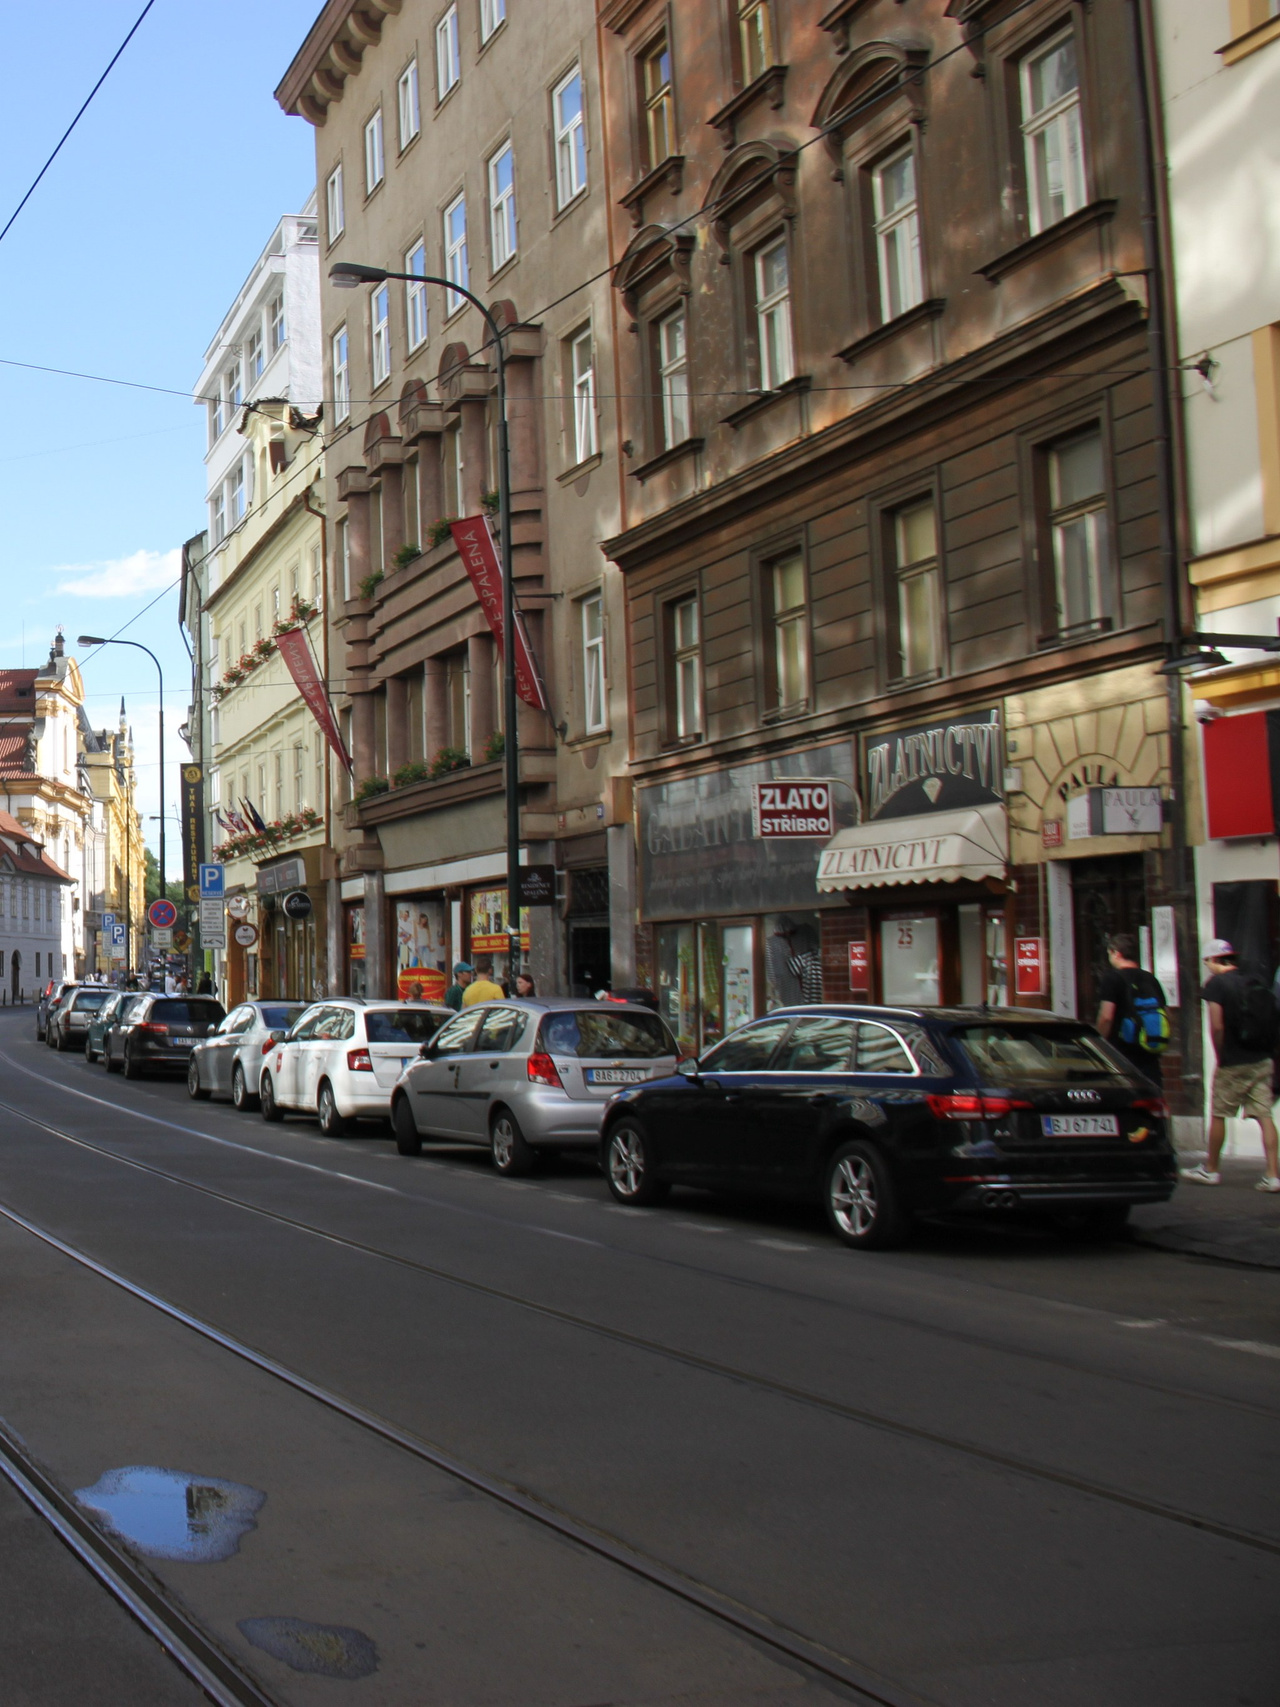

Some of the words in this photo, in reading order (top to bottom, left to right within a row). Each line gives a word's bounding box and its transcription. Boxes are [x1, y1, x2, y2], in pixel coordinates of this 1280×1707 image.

[867, 708, 1004, 819] ZLATNICTVÍ
[1057, 764, 1119, 802] PAULA
[188, 787, 196, 813] THAI
[760, 787, 828, 811] ZLATO
[1104, 790, 1162, 807] PAULA
[761, 814, 830, 833] STŘÍBRO
[189, 817, 198, 881] RESTAURANT
[821, 838, 948, 876] ZLATNICTVÍ
[204, 867, 220, 889] P
[104, 915, 113, 928] P
[113, 926, 123, 940] P
[897, 927, 914, 946] 25
